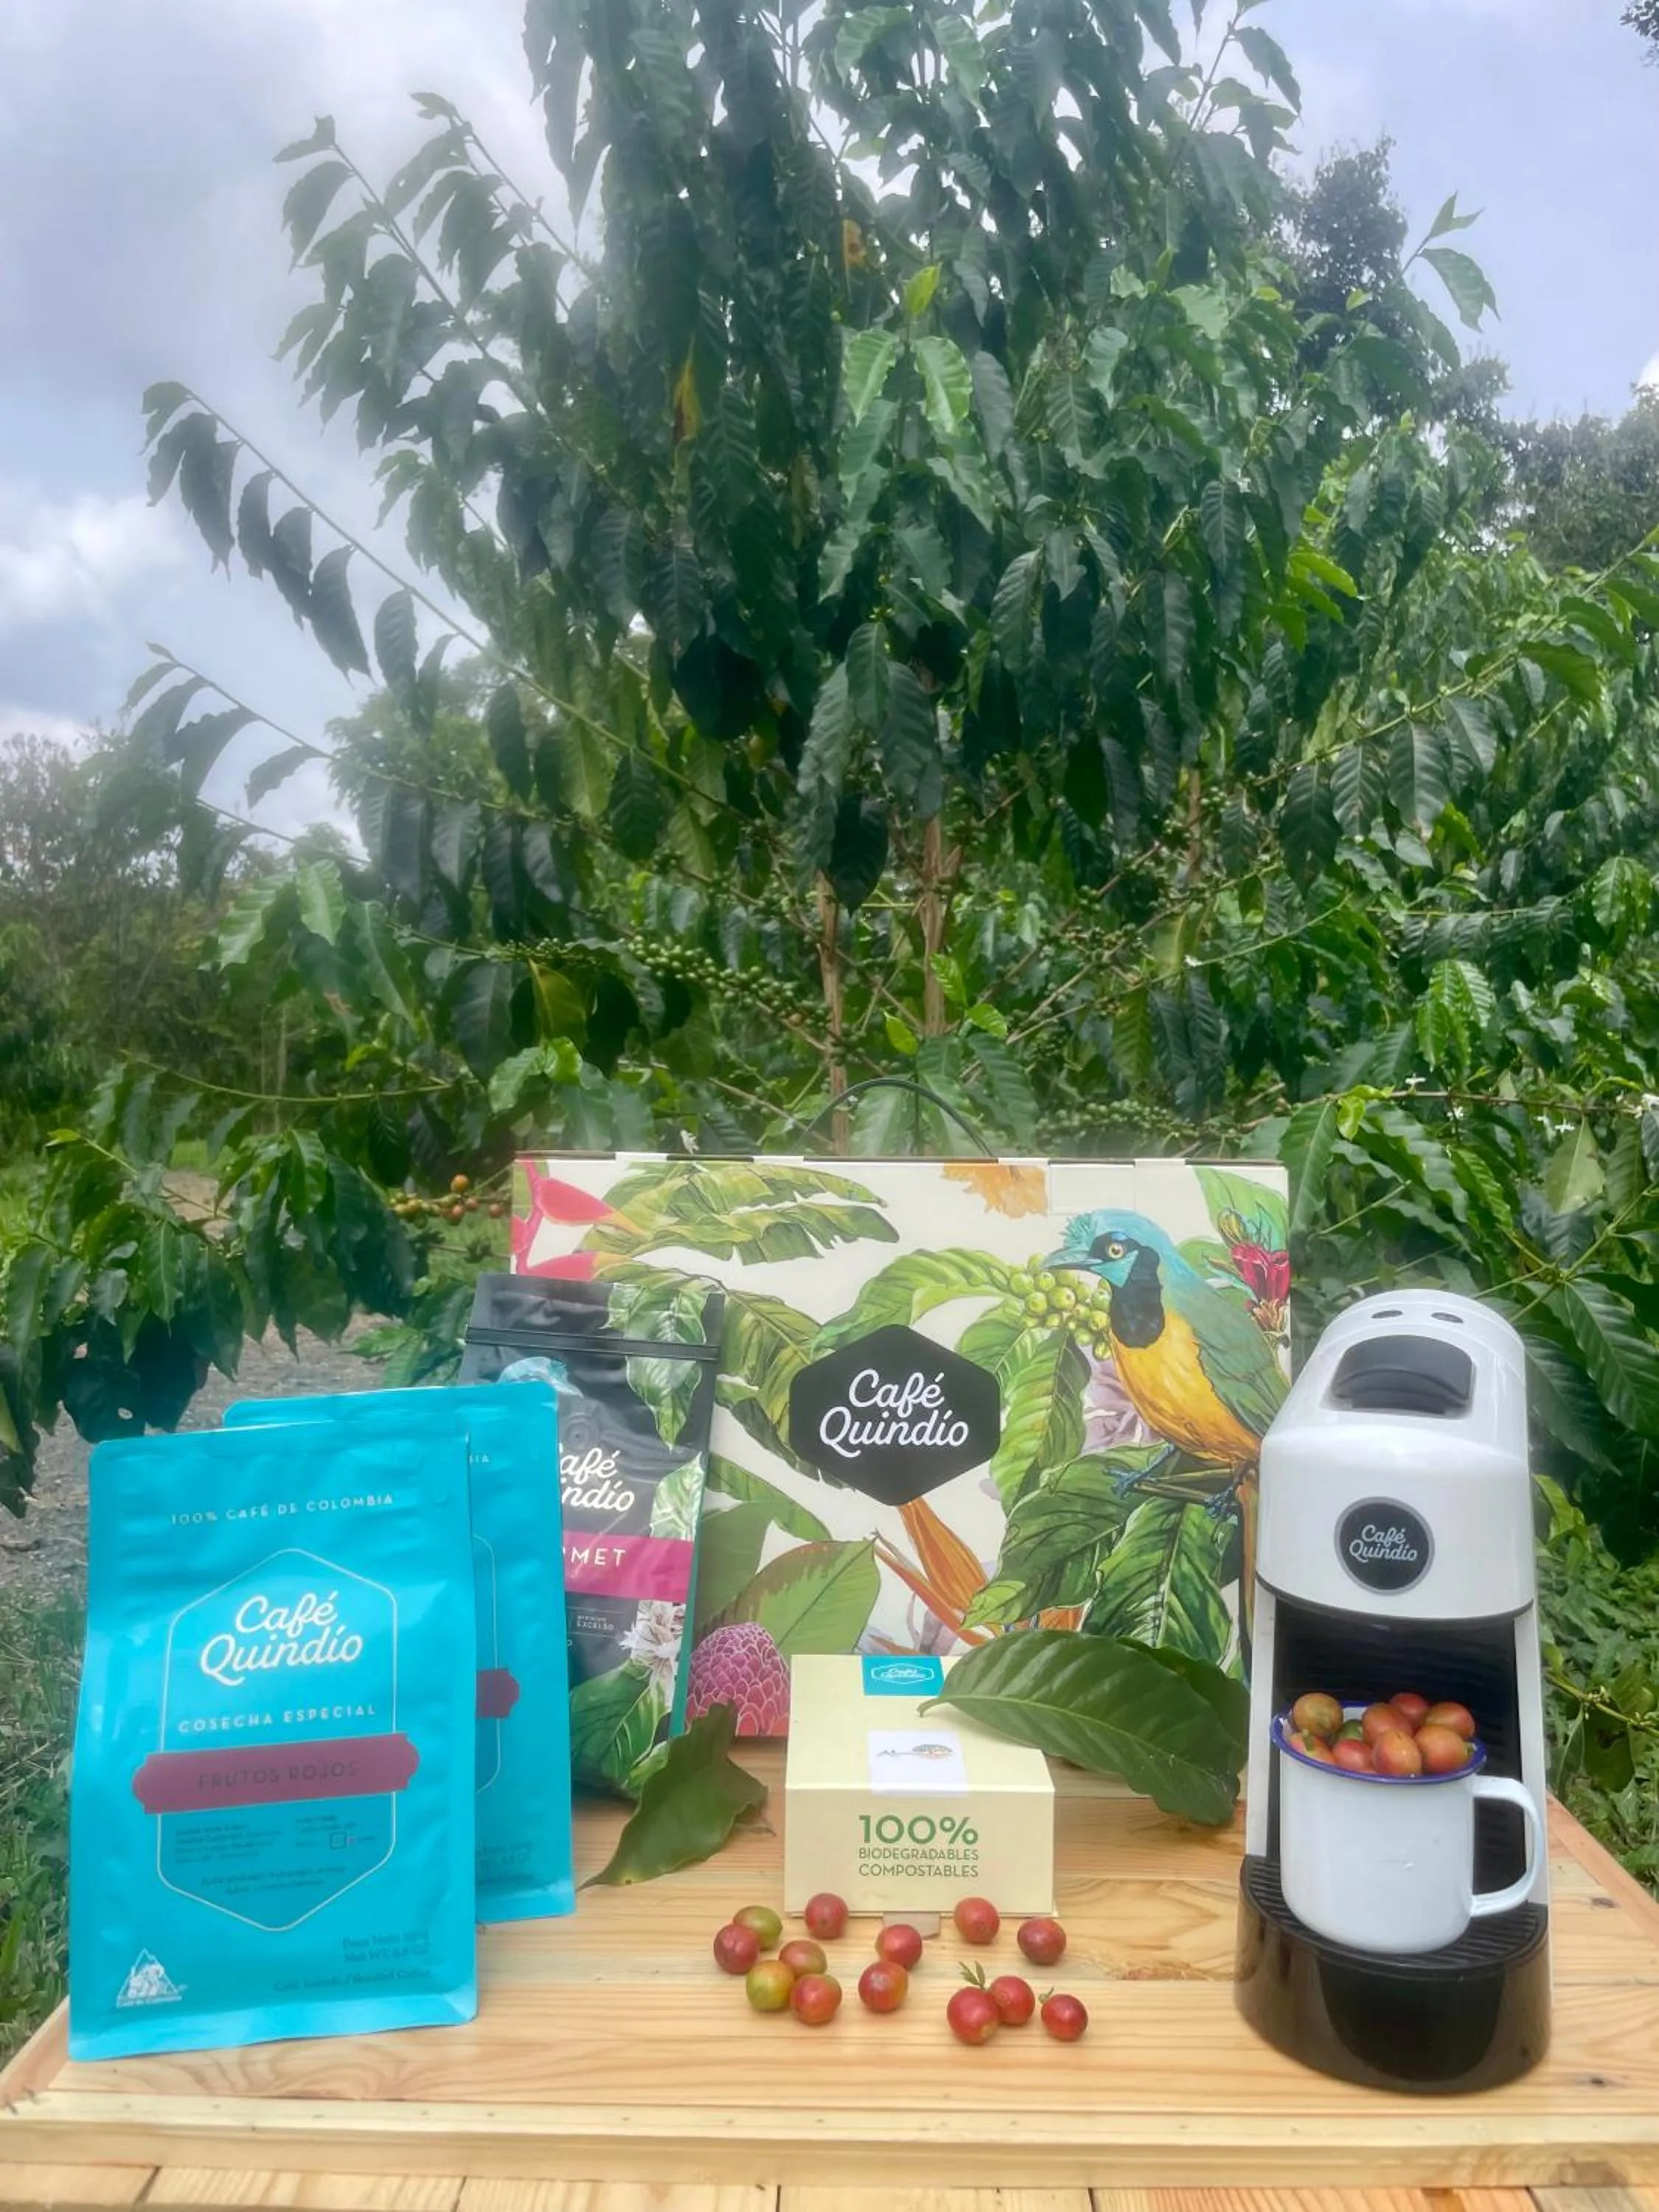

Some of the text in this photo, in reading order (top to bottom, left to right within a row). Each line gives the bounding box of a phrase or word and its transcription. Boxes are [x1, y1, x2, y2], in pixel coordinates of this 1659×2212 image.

[849, 1368, 945, 1418] Café
[819, 1406, 969, 1458] Quindío
[559, 1442, 621, 1484] afé
[171, 1494, 393, 1525] 100% CAFÉ DE COLOMBIA
[560, 1478, 635, 1512] ndío
[1361, 1524, 1406, 1547] Café
[1349, 1539, 1418, 1563] Quindío
[235, 1590, 338, 1638] Café
[201, 1624, 363, 1686] Quindío
[178, 1705, 376, 1733] COSECHA ESPECIAL
[198, 1761, 357, 1790] FRUTOS ROJOS
[858, 1815, 978, 1845] 100%
[858, 1848, 978, 1861] BIODEGRADABLES
[858, 1863, 978, 1878] COMPOSTABLES
